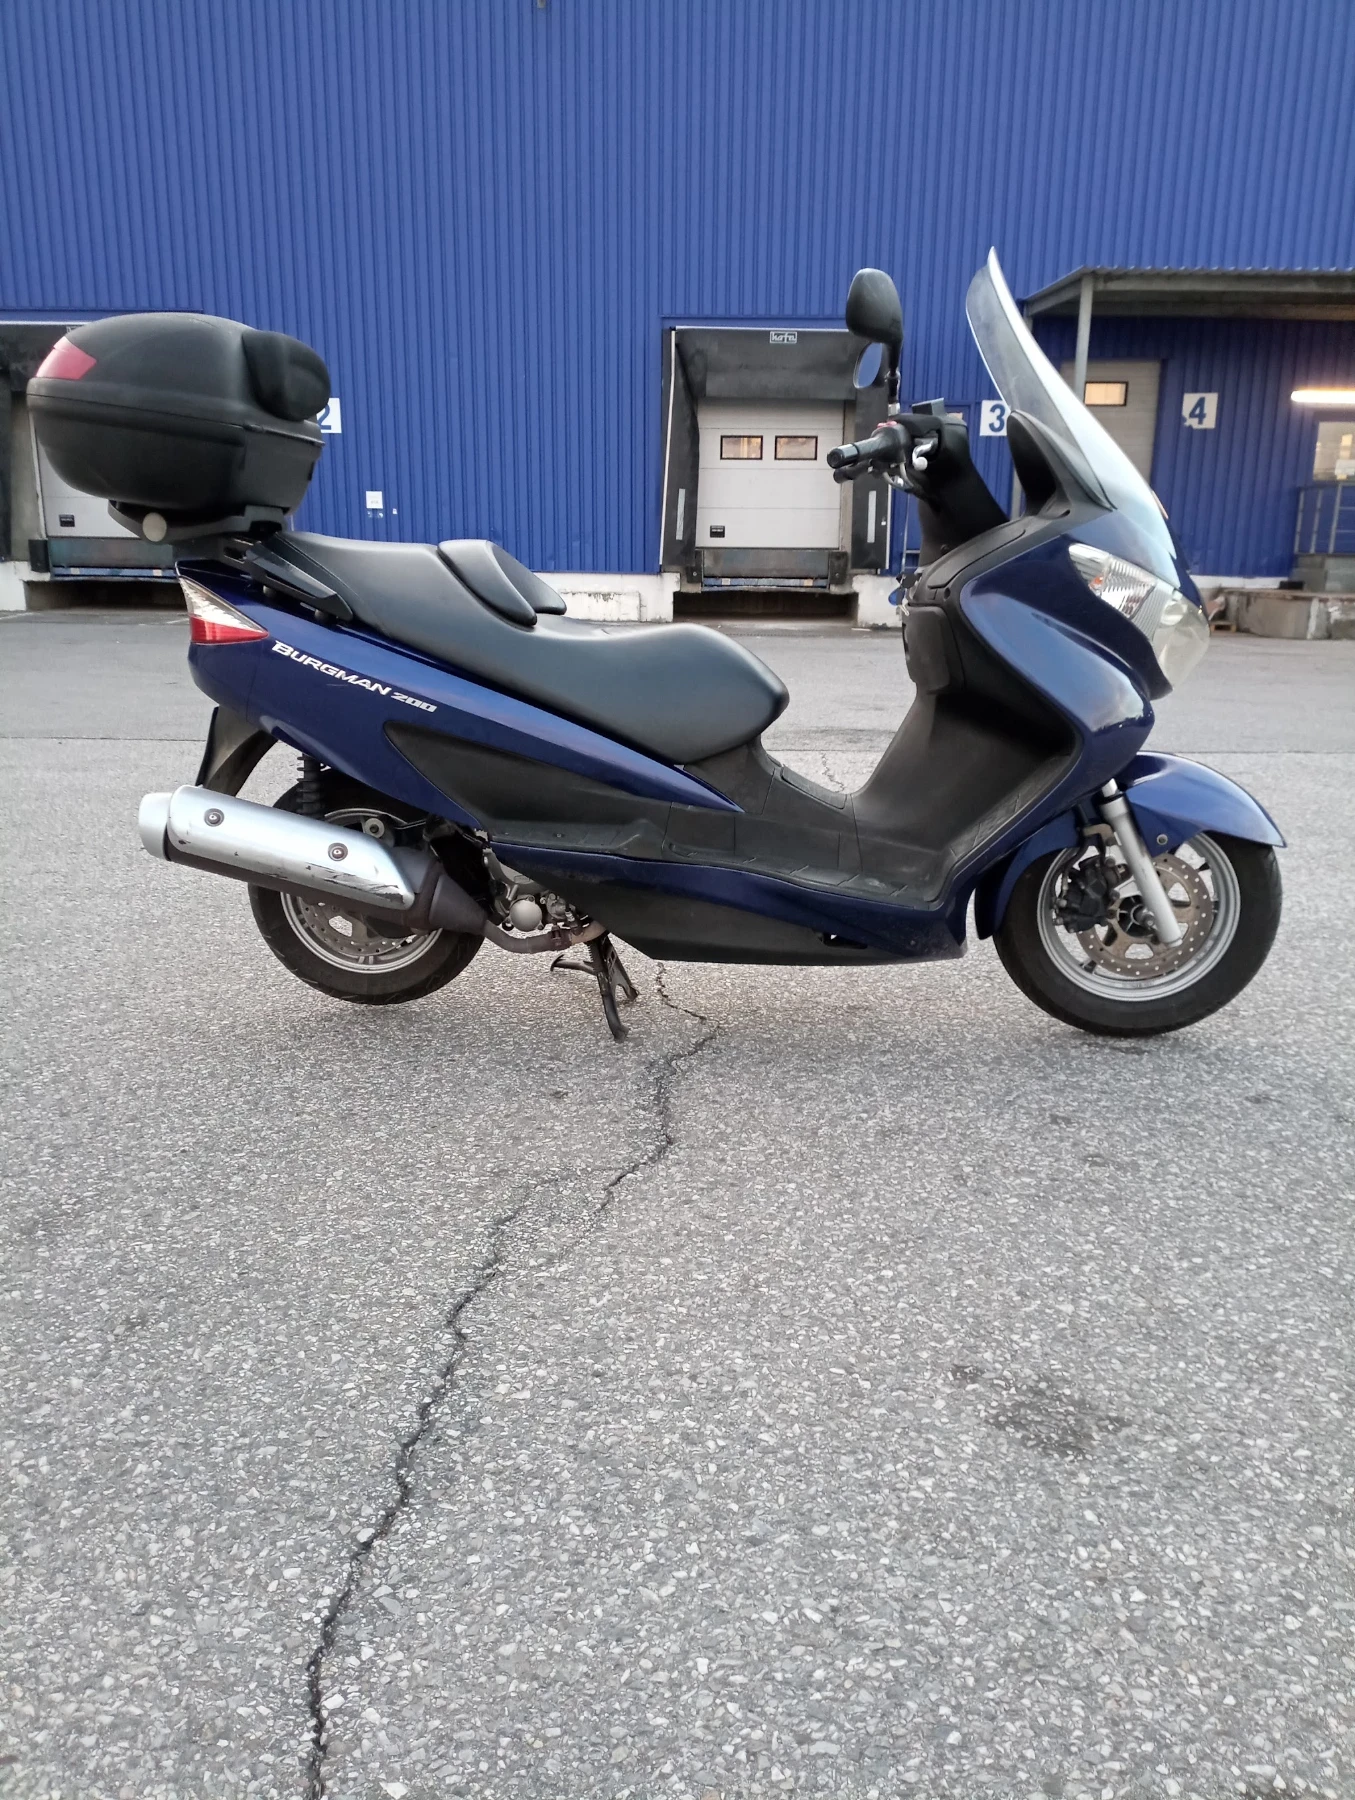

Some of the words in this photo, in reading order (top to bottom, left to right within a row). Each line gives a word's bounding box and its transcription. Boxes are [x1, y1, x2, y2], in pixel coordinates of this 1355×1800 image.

[317, 403, 332, 431] 2
[988, 403, 1006, 433] 3
[1189, 396, 1207, 425] 4
[271, 640, 392, 696] BURGMAN
[390, 691, 438, 713] 200
